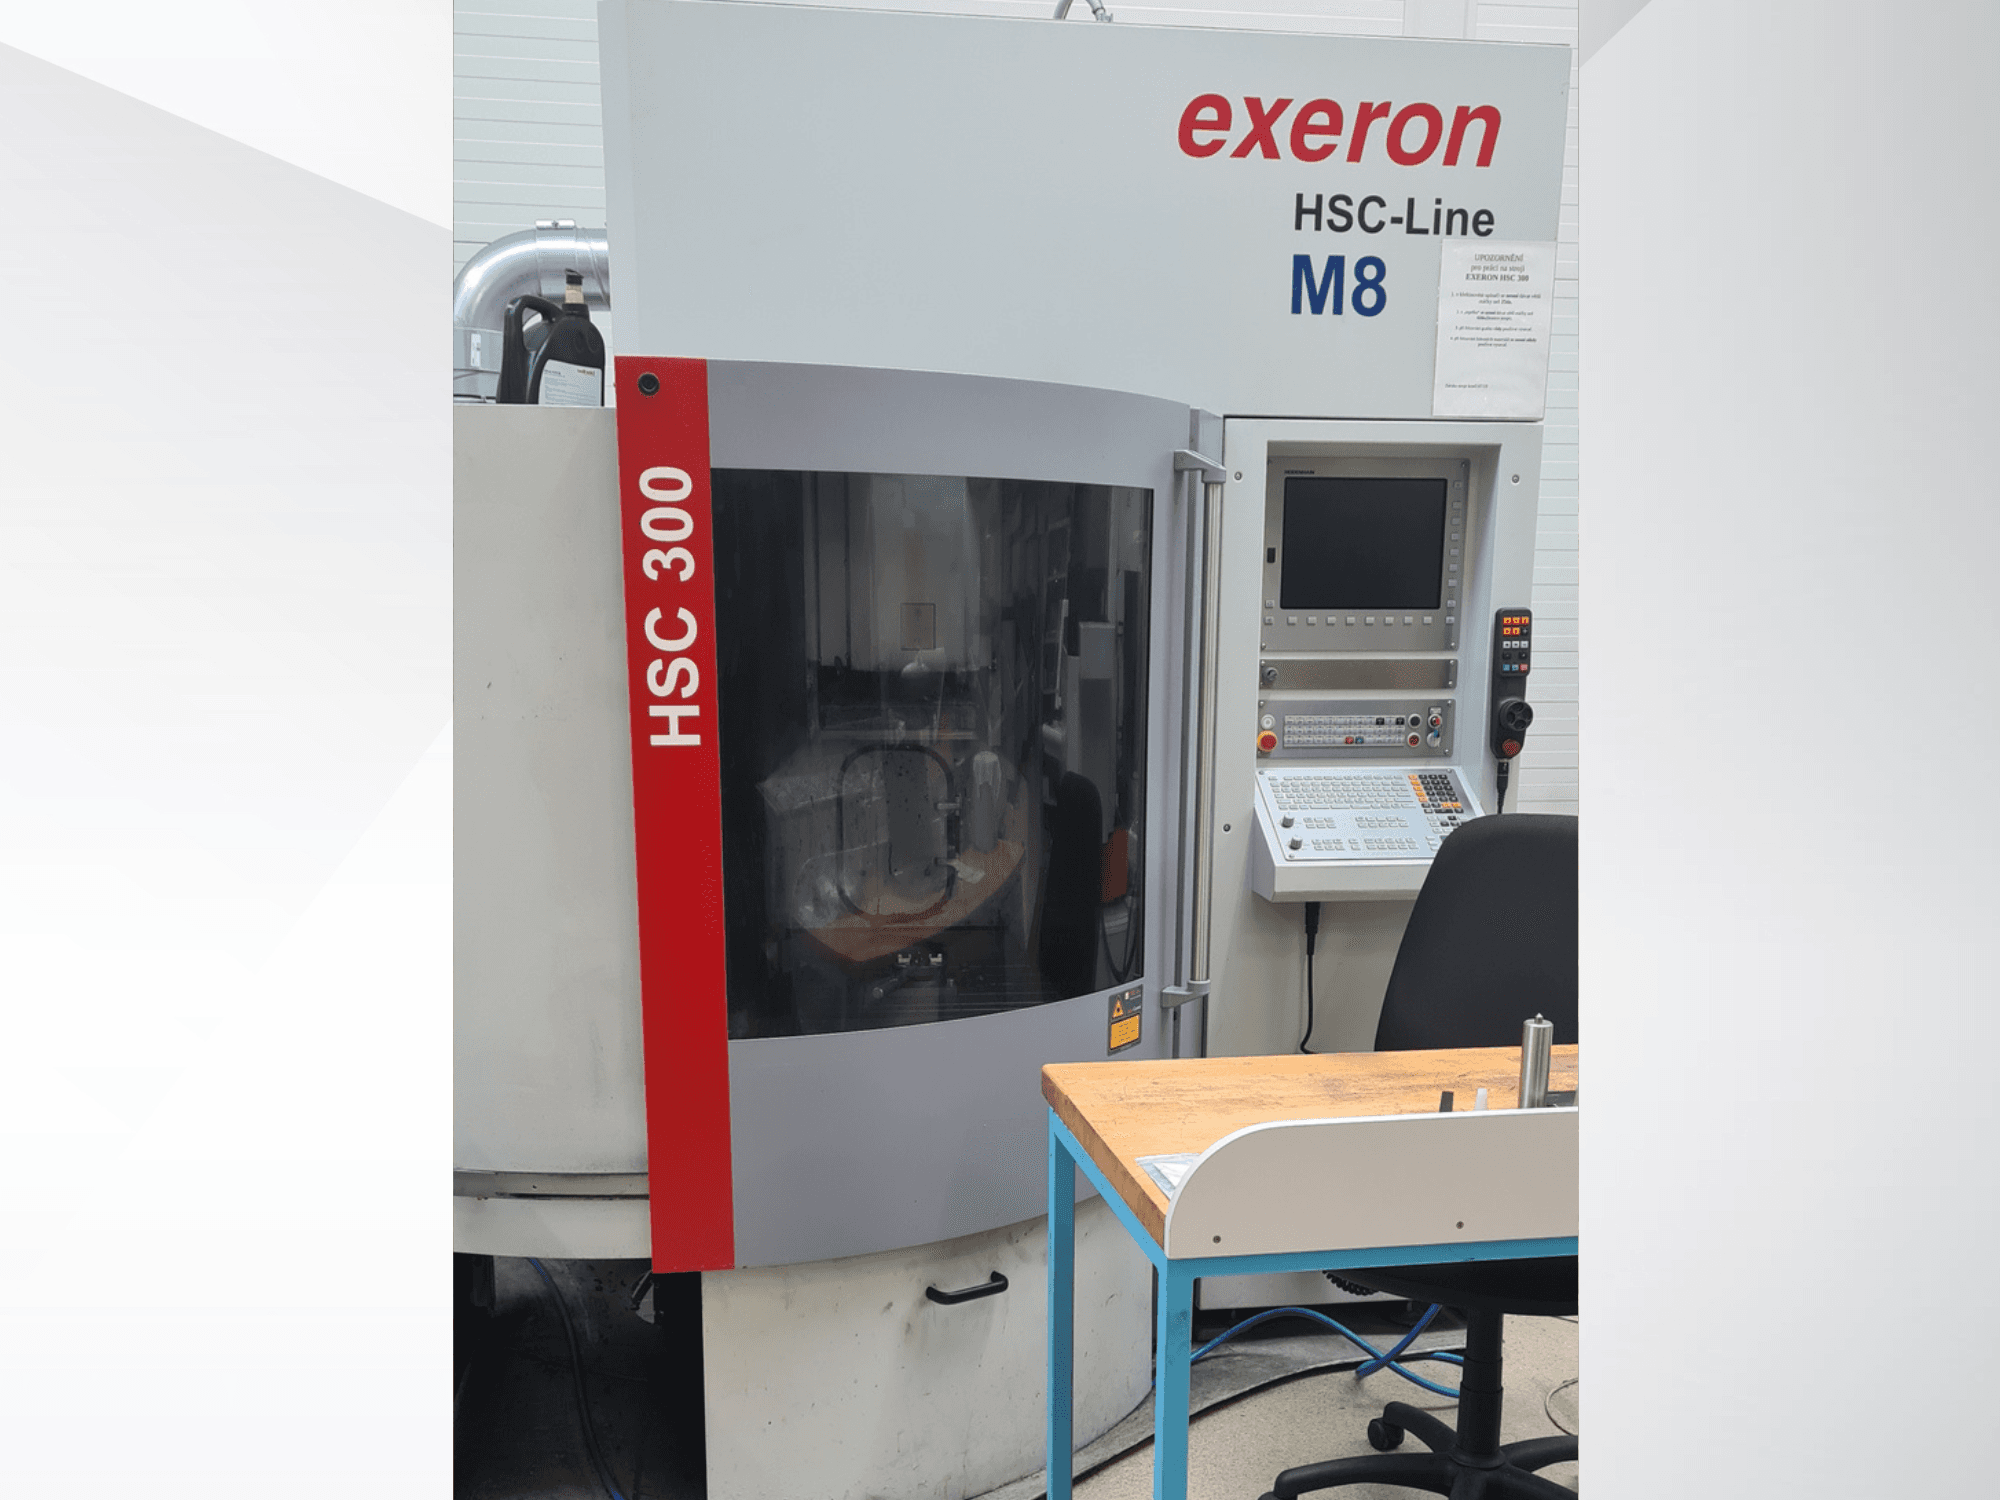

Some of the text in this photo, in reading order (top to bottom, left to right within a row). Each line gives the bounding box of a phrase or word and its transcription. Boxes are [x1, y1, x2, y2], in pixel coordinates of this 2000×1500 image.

[1178, 94, 1501, 168] exeron
[1294, 193, 1495, 237] HSC-Line
[1290, 253, 1387, 317] M8
[1465, 273, 1499, 281] EXERON
[1500, 273, 1516, 282] HSC
[638, 466, 701, 746] HSC 300
